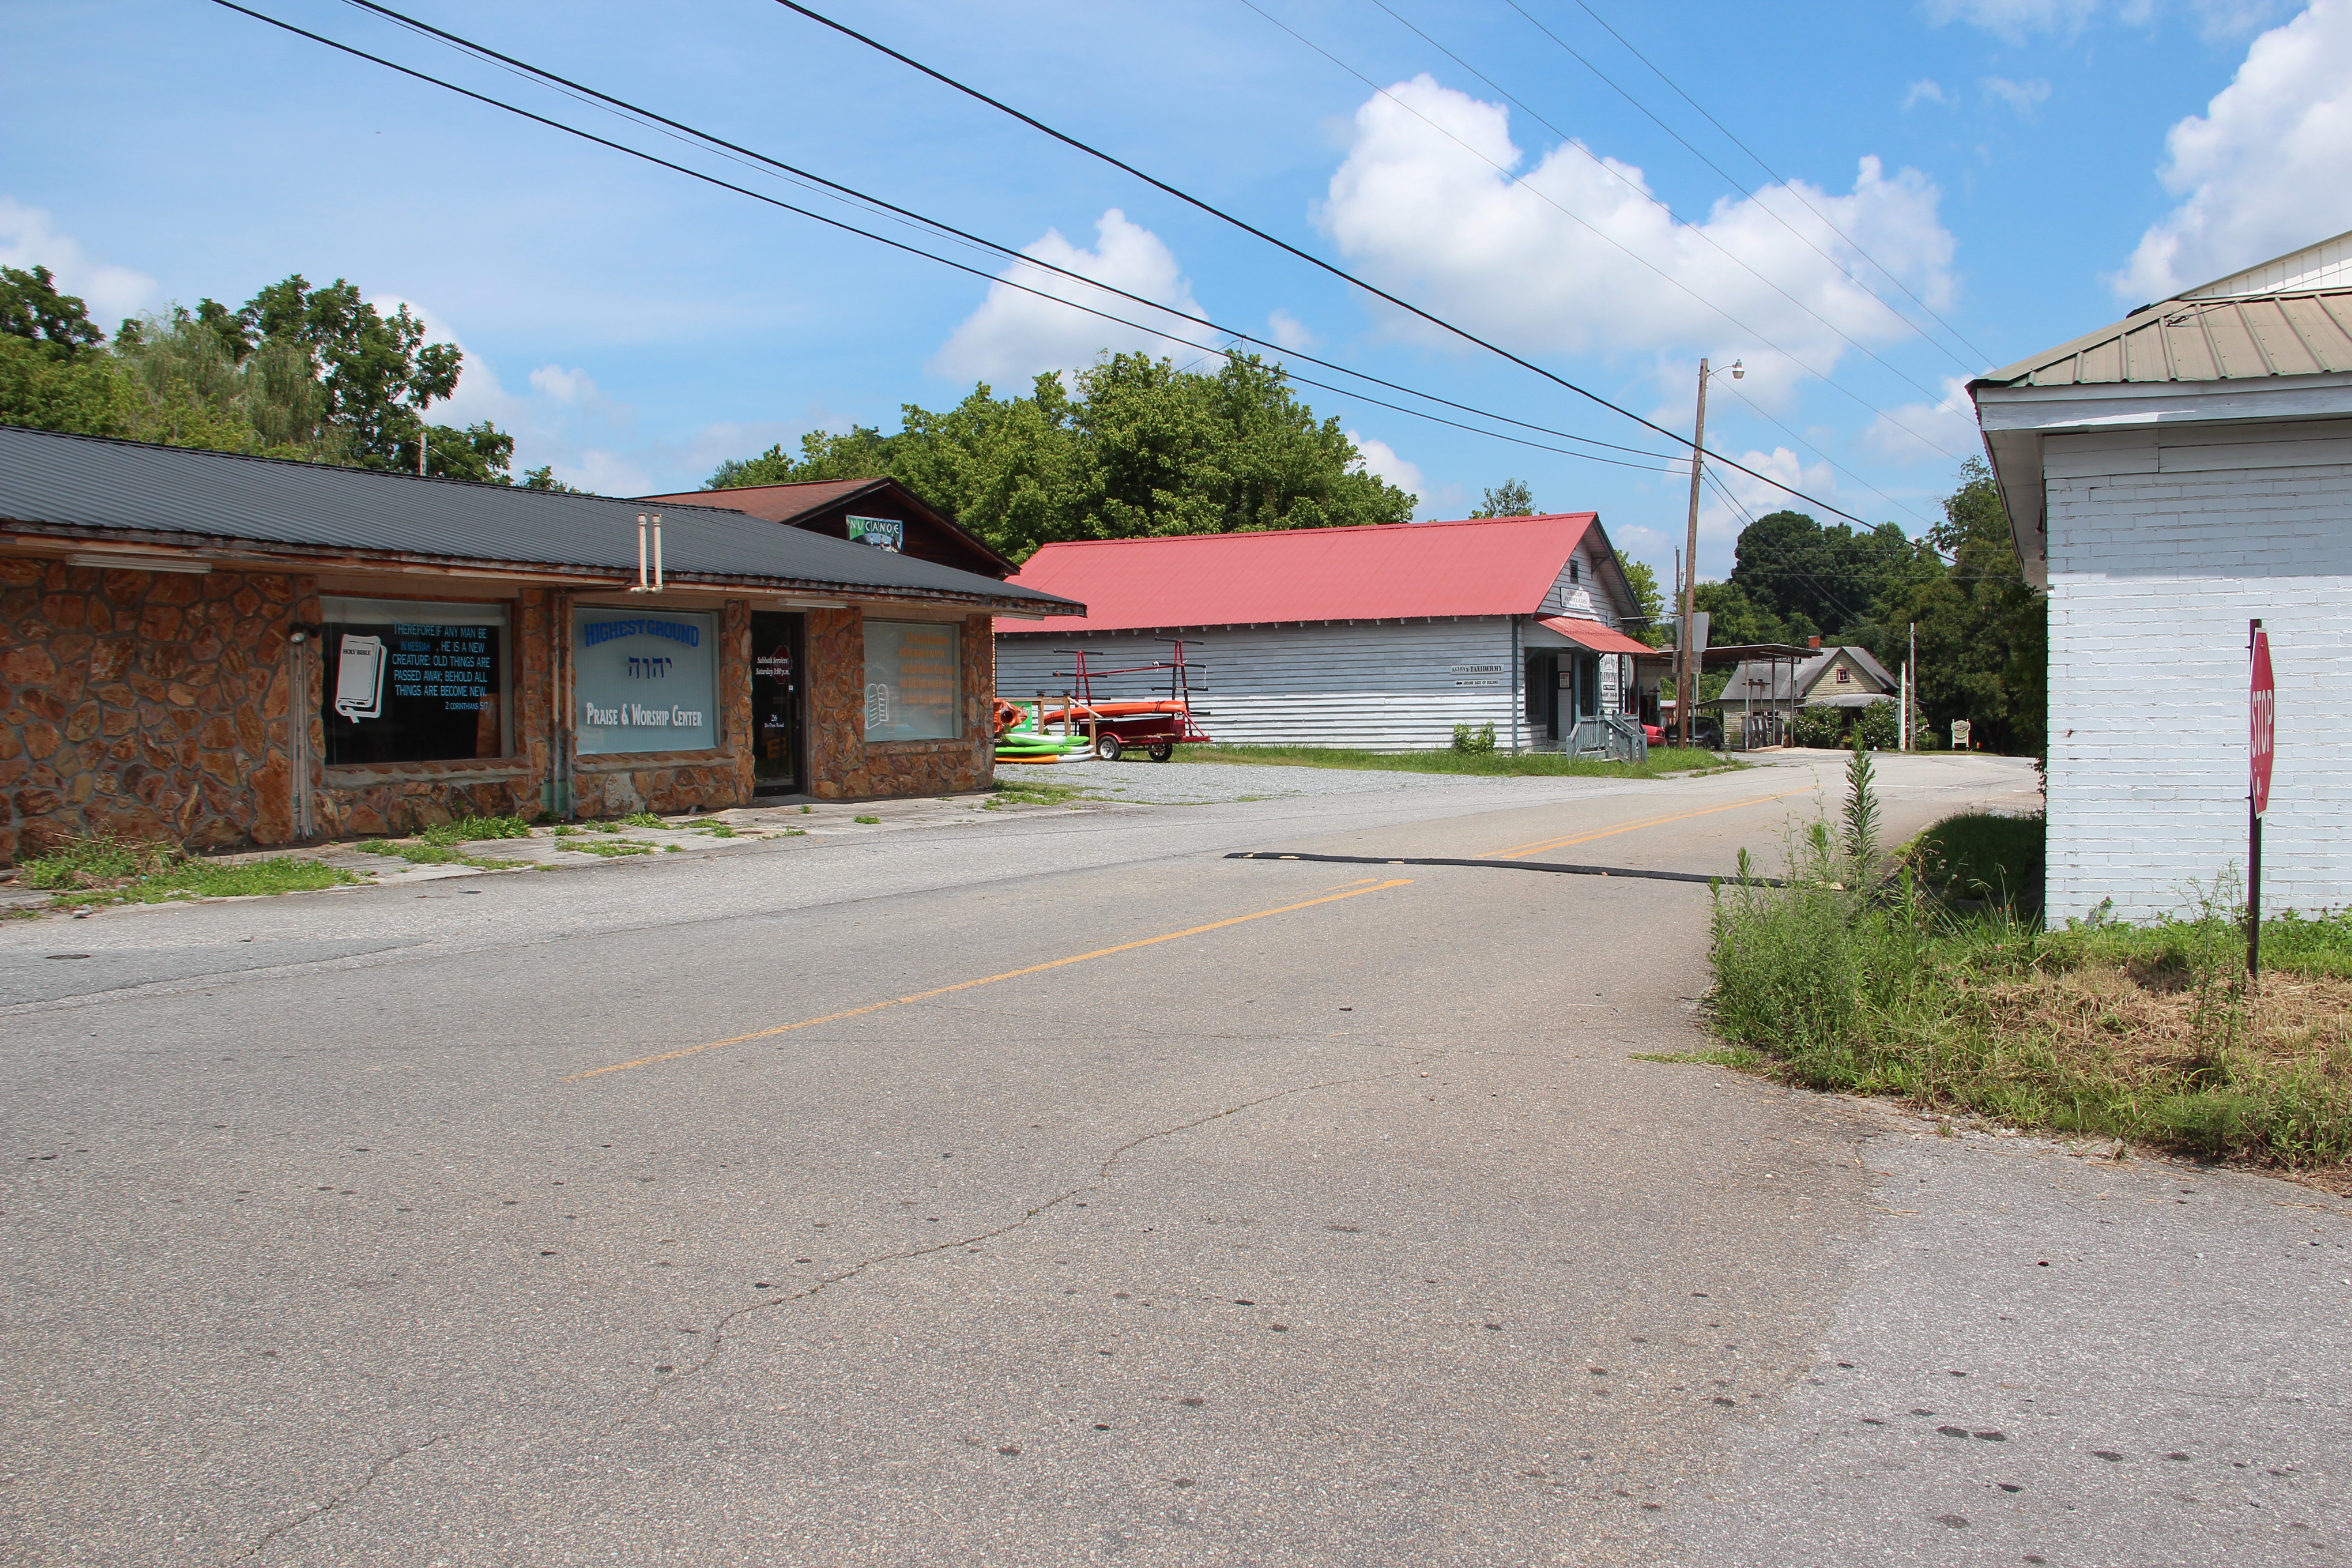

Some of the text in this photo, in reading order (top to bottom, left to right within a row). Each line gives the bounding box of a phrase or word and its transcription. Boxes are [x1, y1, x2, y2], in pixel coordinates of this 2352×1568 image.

[392, 621, 487, 639] THEREFORE IF ANY MAN BE
[585, 619, 699, 647] HIGHEST GROUND
[407, 641, 431, 651] MESSIAH
[441, 640, 451, 652] HE
[453, 641, 459, 653] IS
[461, 642, 467, 653] A
[468, 642, 485, 653] NEW
[392, 653, 491, 668] CREATURE: OLD THINGS ARE
[757, 656, 772, 664] Sabbath
[628, 656, 672, 679] יהוה
[755, 668, 773, 676] Saturday
[394, 669, 421, 681] PASSED
[444, 670, 472, 682] BEHOLD
[474, 672, 487, 683] ALL
[395, 685, 421, 696] THINGS
[423, 685, 438, 696] ARE
[440, 685, 468, 697] BECOME
[445, 702, 449, 710] 2
[621, 704, 629, 725] &
[771, 714, 778, 722] 26
[2252, 689, 2272, 758] STOP
